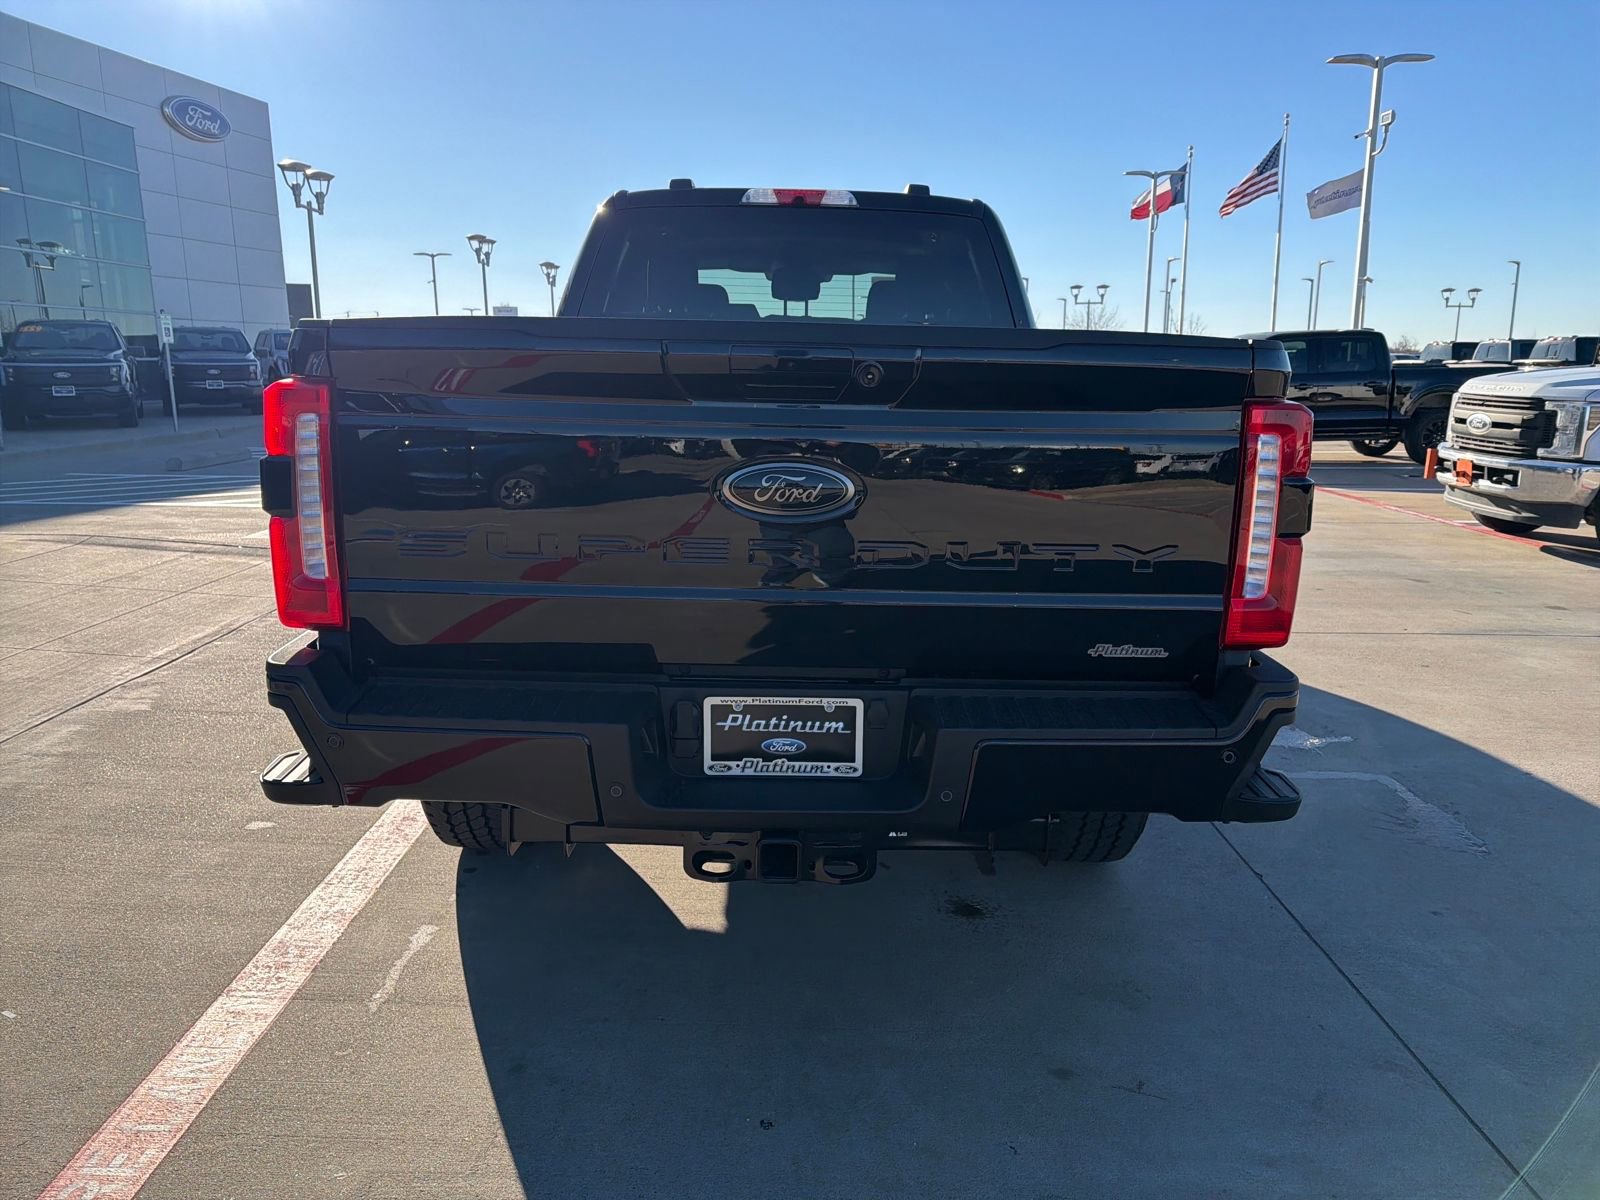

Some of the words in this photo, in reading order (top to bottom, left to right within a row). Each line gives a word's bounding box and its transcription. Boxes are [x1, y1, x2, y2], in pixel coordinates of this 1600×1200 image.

[185, 105, 220, 134] Ford
[753, 473, 823, 503] Ford
[396, 528, 820, 567] SUPER
[854, 540, 1180, 573] DUTY
[1087, 643, 1169, 658] Platinum
[719, 697, 849, 706] www.PlatinumFord.com
[715, 713, 852, 734] Platinum
[769, 740, 798, 753] Ford
[740, 758, 832, 774] Platinum
